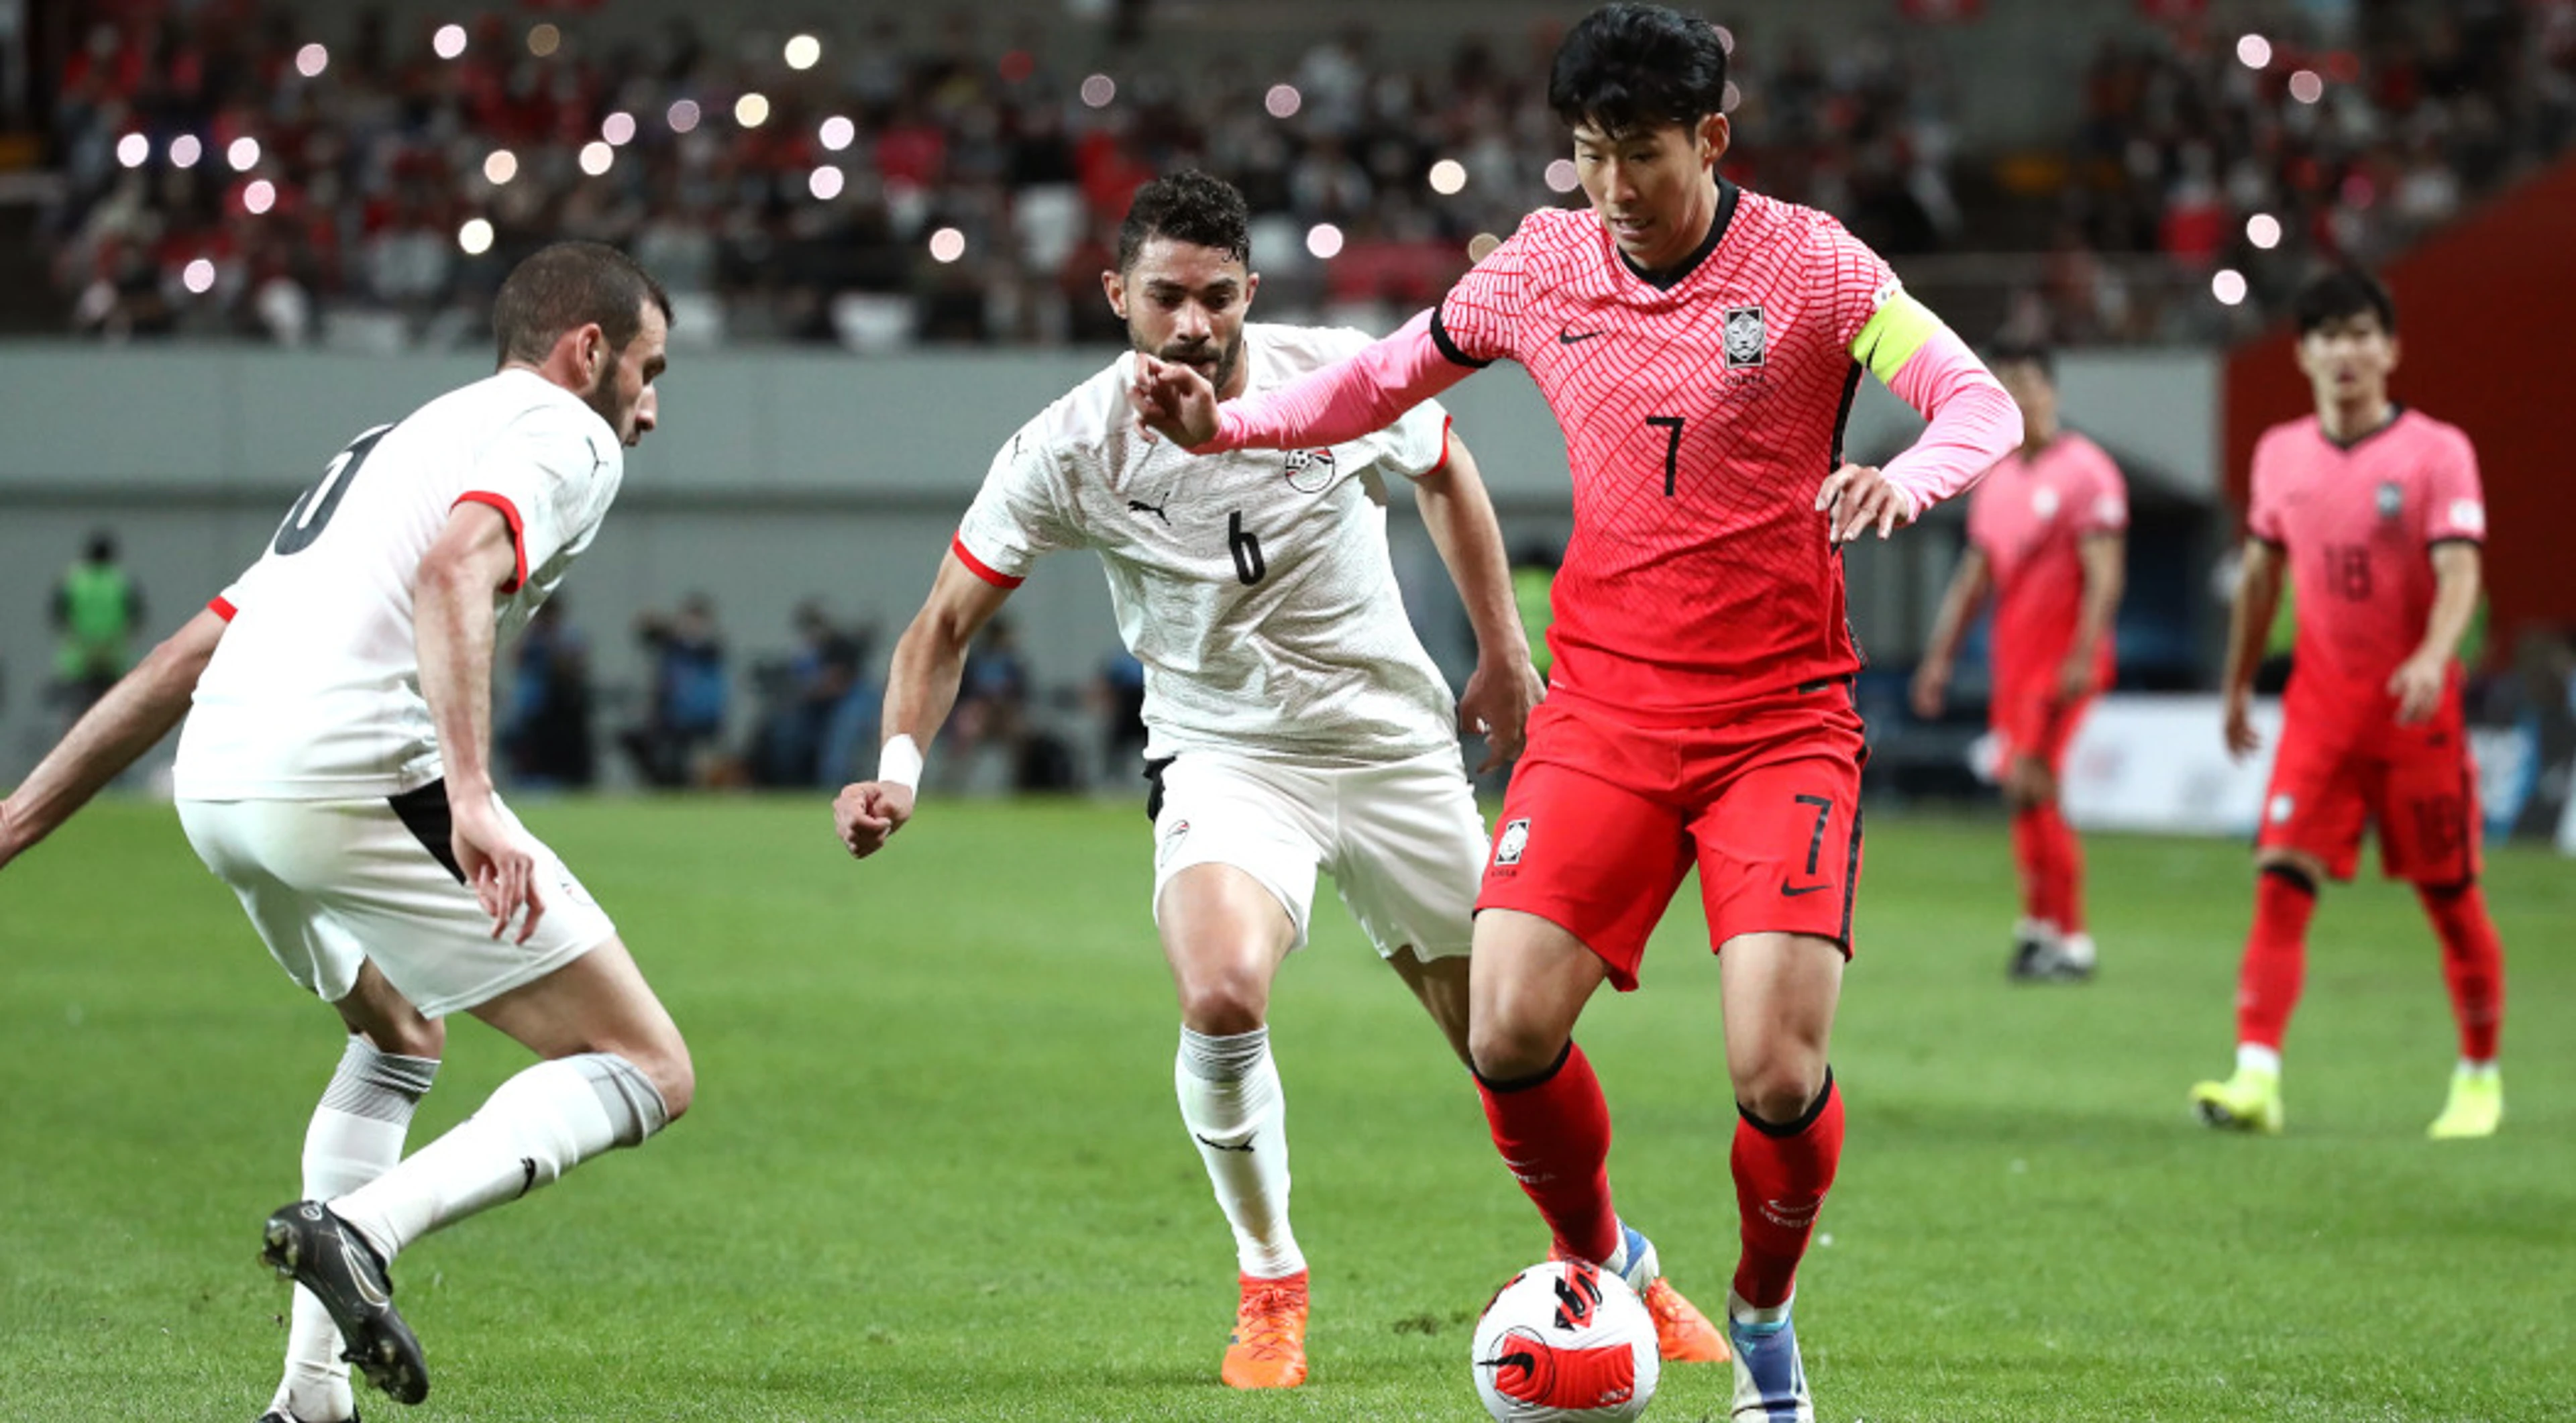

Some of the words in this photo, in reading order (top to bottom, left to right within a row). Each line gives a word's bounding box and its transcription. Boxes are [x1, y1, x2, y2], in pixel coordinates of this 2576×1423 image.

[1646, 416, 1685, 496] 7
[1228, 510, 1266, 586] 6
[2322, 545, 2373, 602] 18
[1795, 794, 1833, 875] 7
